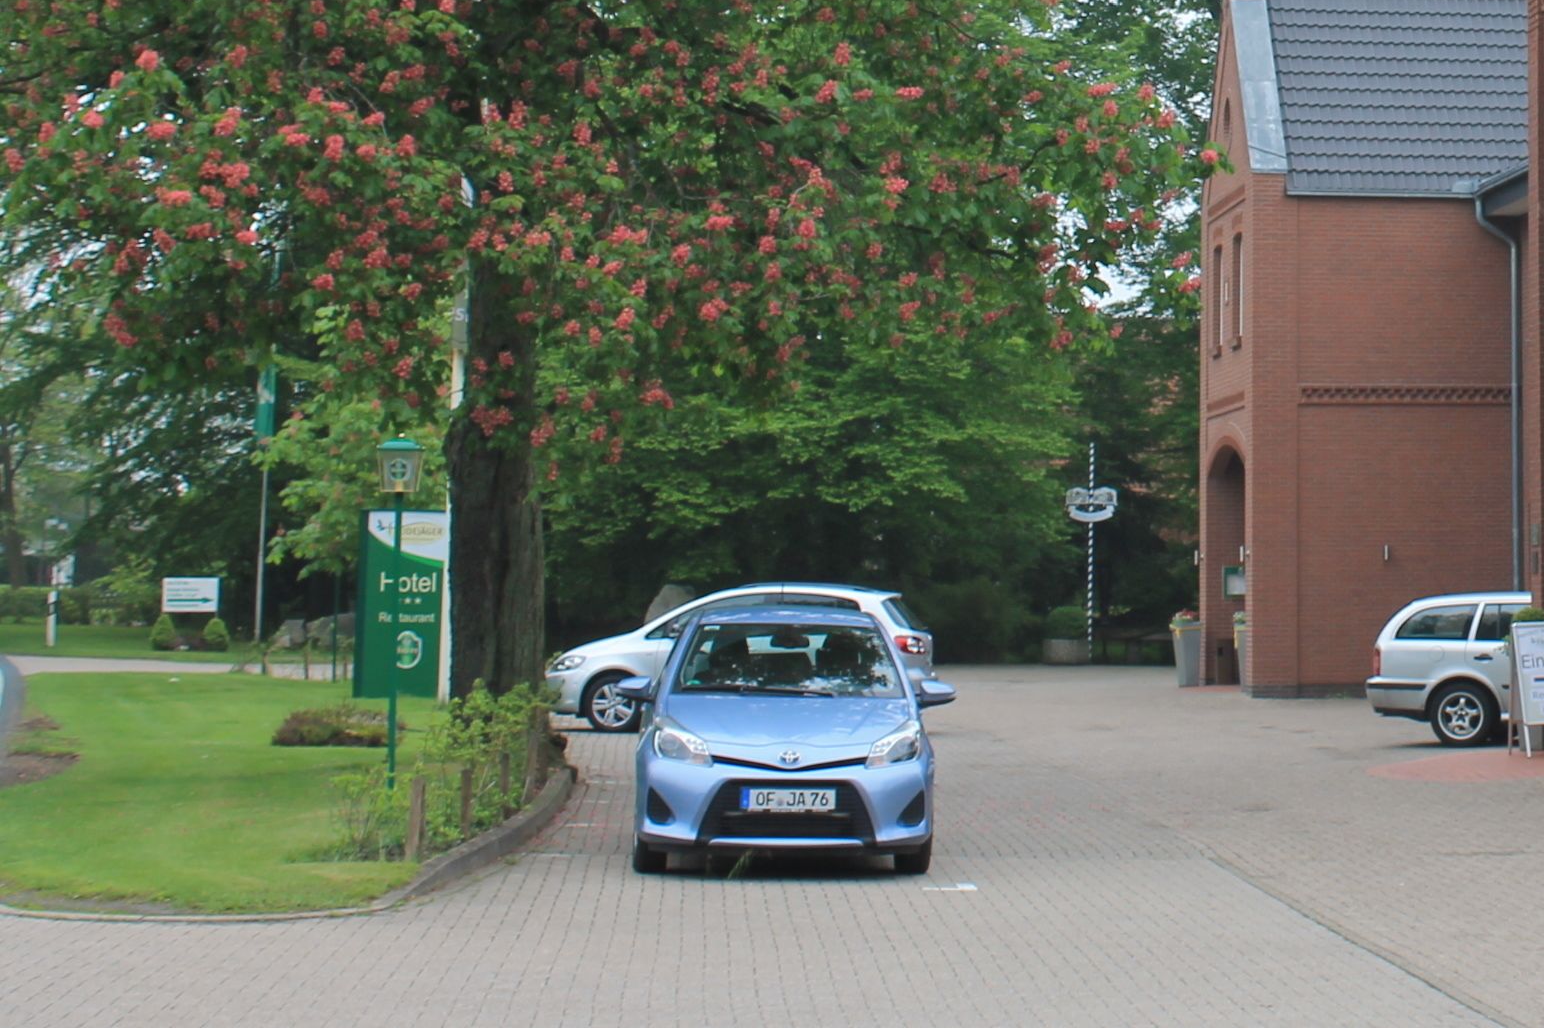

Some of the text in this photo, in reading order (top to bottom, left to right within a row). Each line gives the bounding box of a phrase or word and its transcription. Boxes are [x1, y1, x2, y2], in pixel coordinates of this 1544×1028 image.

[378, 612, 435, 623] Retaurant
[755, 791, 829, 806] OF JA 76
